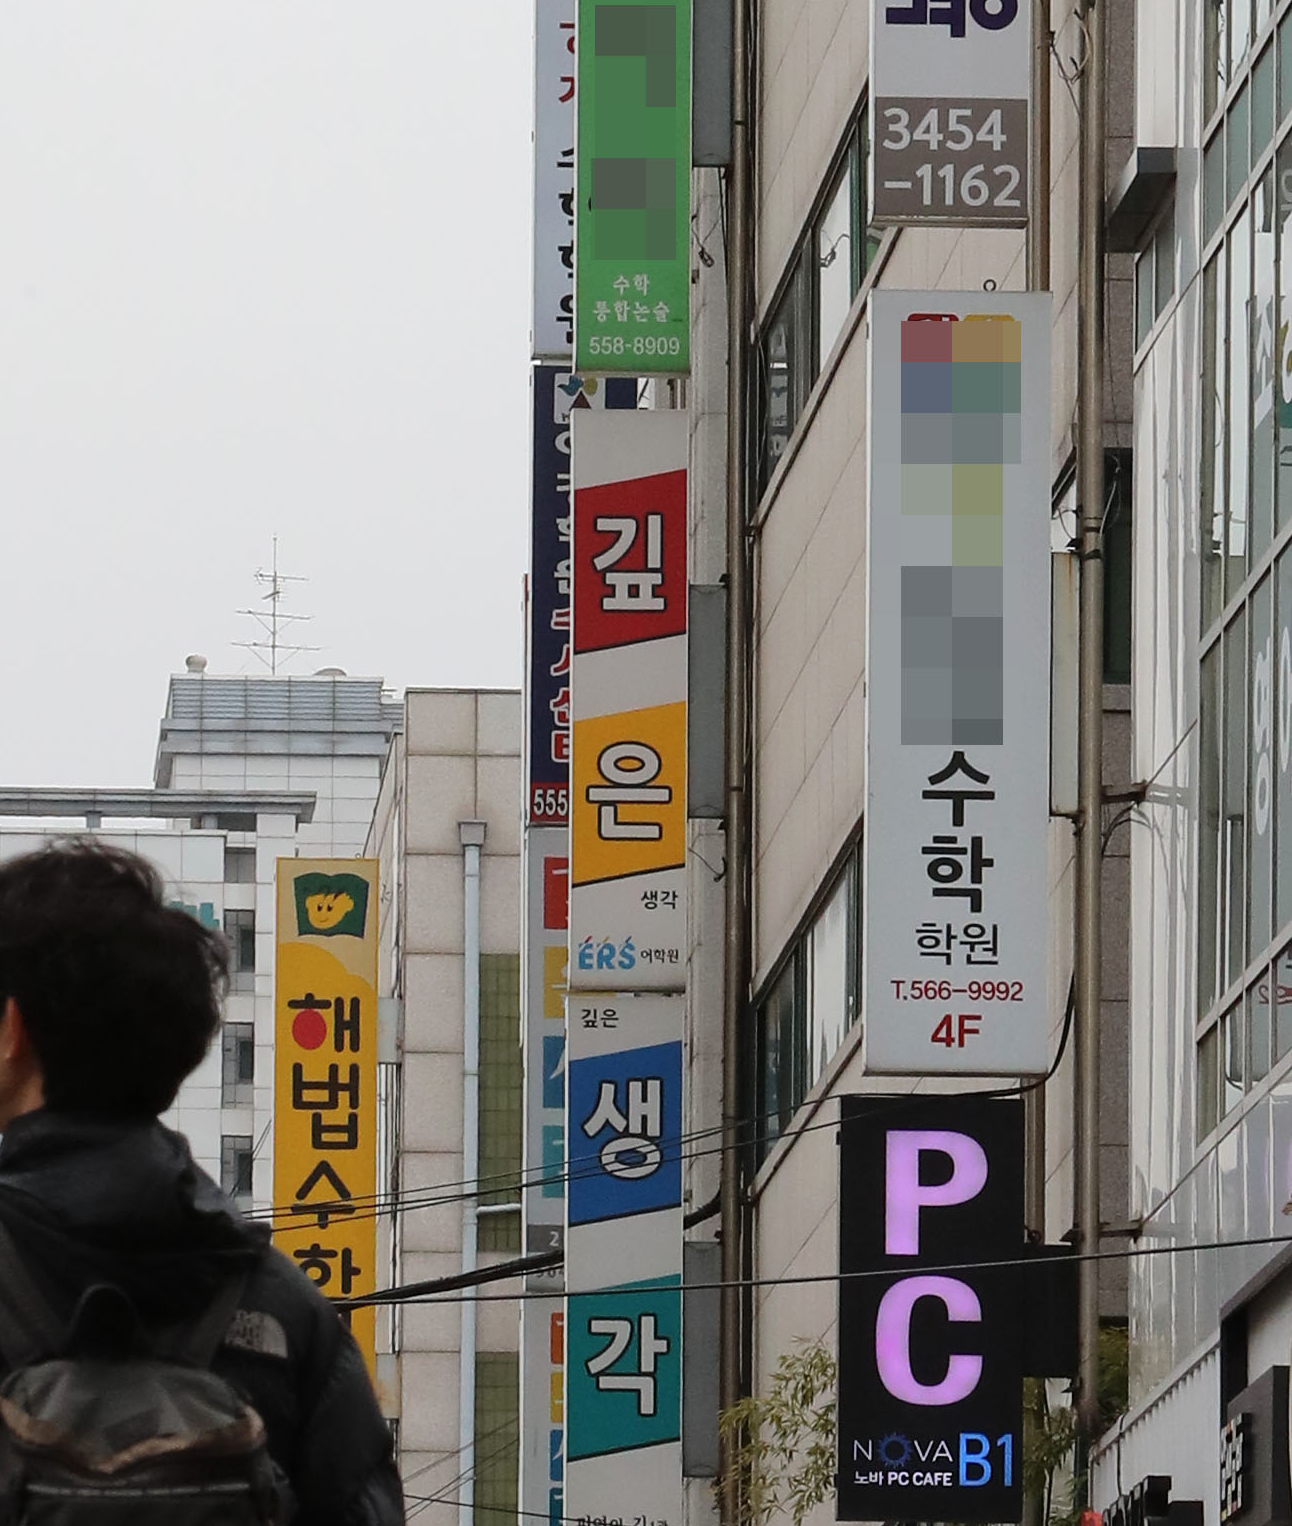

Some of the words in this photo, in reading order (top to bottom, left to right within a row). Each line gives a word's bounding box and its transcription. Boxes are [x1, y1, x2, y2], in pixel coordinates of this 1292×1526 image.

[883, 107, 1006, 151] 3454
[883, 163, 1022, 208] -1162
[612, 274, 650, 296] 수학
[592, 300, 670, 323] 통합논술
[589, 336, 680, 355] 558-8909
[922, 751, 996, 915] 수학
[641, 890, 679, 910] 생각
[640, 948, 680, 964] 어학원
[915, 921, 1000, 969] 학원
[891, 979, 1024, 1003] T.566-9992
[581, 1008, 620, 1029] 깊은
[931, 1014, 983, 1049] 4F
[853, 1432, 955, 1468] NOVA
[959, 1432, 1013, 1487] B1
[854, 1471, 884, 1486] 노바
[887, 1471, 909, 1486] PC
[912, 1471, 953, 1487] CAFE
